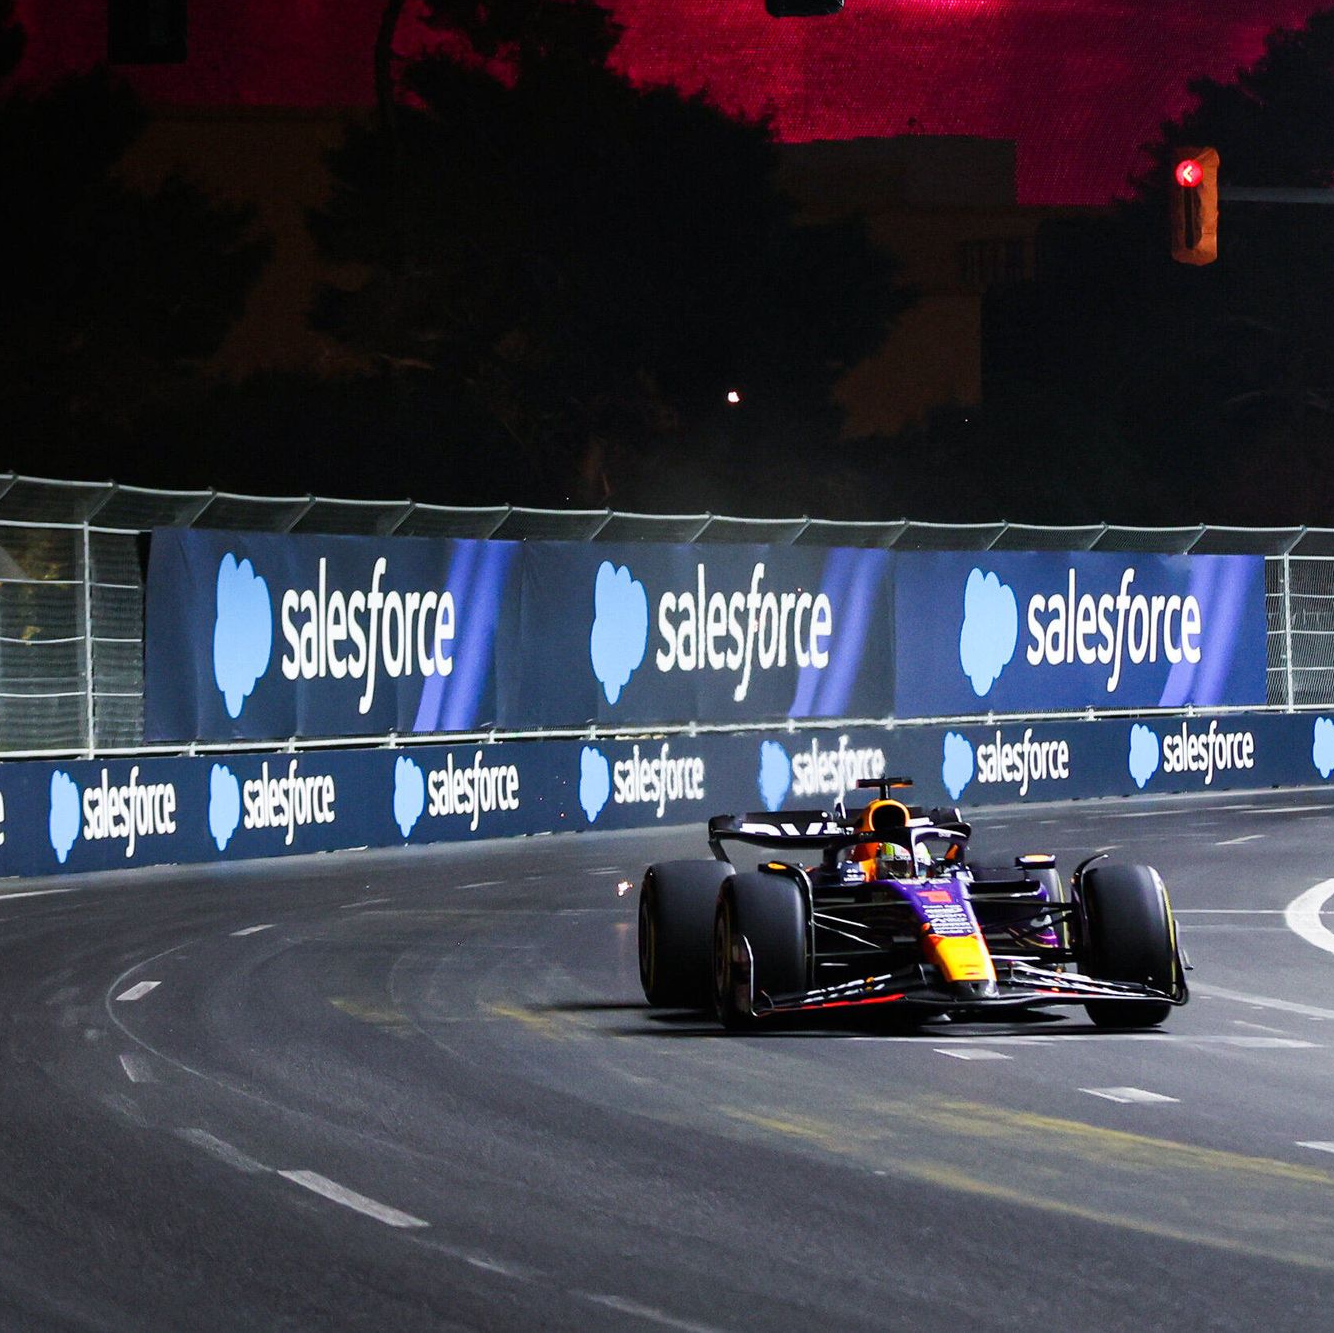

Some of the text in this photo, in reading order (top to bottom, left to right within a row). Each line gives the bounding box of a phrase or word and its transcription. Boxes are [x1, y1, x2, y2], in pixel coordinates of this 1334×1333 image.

[282, 558, 455, 714] salesforce
[656, 563, 832, 702] salesforce
[1027, 568, 1200, 692] salesforce
[428, 750, 520, 831] salesforce
[613, 743, 705, 818] salesforce
[792, 735, 886, 808] salesforce
[977, 729, 1069, 796] salesforce
[1163, 720, 1254, 785] salesforce
[83, 765, 176, 858] salesforce
[243, 759, 335, 845] salesforce
